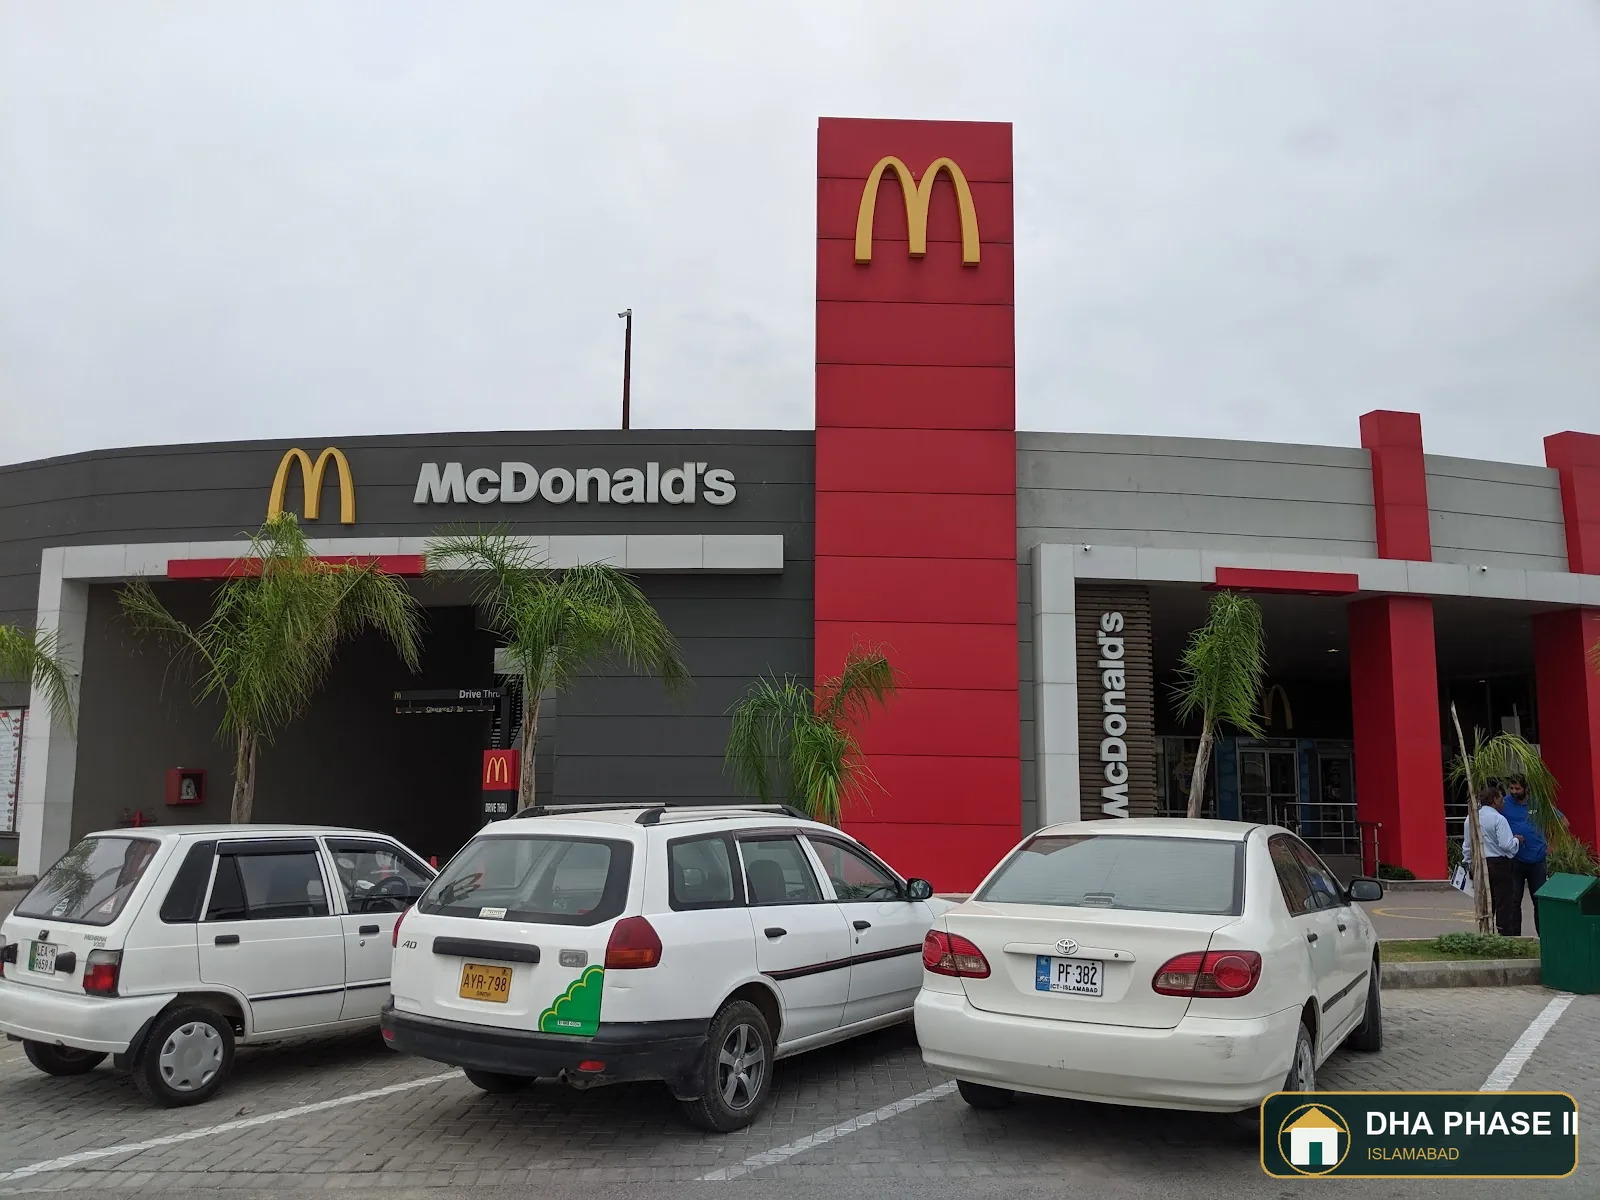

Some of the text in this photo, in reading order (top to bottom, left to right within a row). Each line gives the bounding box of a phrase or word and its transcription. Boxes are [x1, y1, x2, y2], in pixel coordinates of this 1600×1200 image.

[413, 461, 737, 506] McDonald's
[459, 689, 481, 699] Drive
[1097, 611, 1129, 818] McDonald's
[485, 803, 508, 813] DRIVE THRU
[402, 940, 417, 949] AD
[463, 973, 507, 992] AYR-798
[1058, 964, 1097, 985] PF-382
